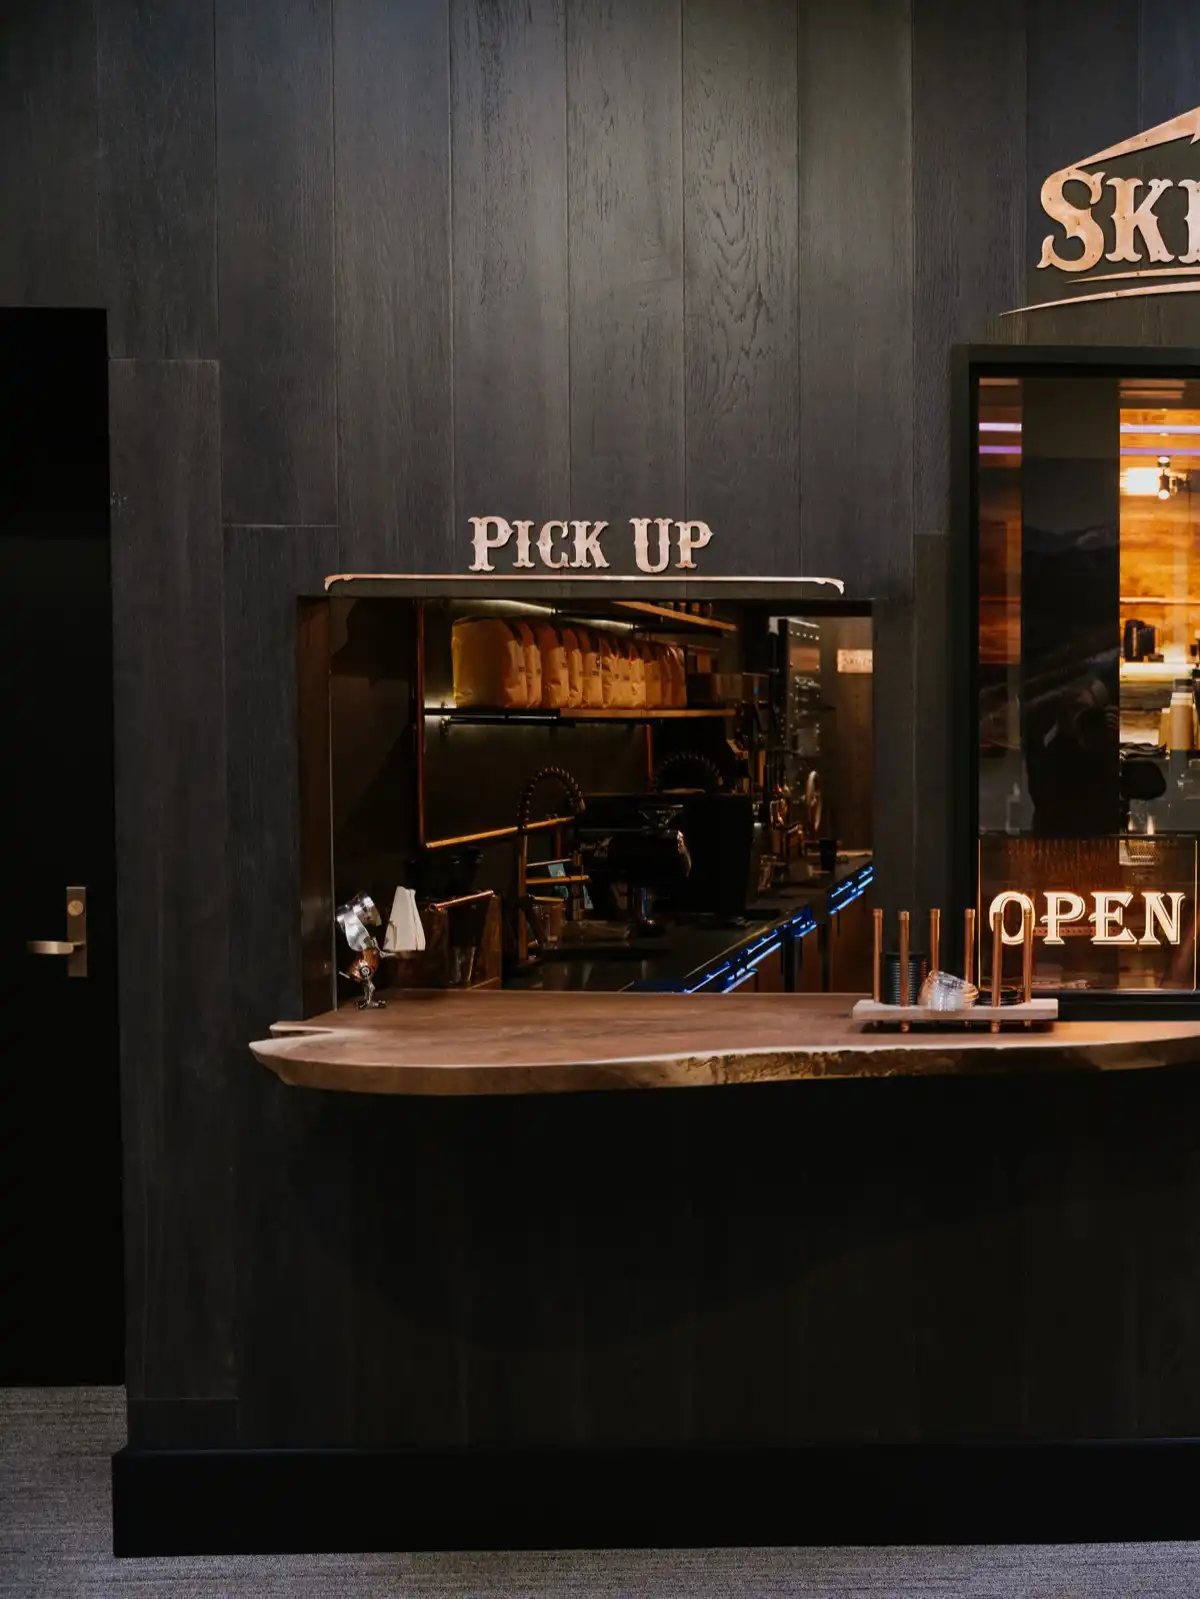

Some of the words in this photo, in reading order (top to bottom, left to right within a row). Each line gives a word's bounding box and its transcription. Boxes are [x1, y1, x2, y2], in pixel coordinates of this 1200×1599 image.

[467, 515, 610, 572] PICK
[628, 517, 714, 573] UP
[988, 889, 1187, 946] OPEN
